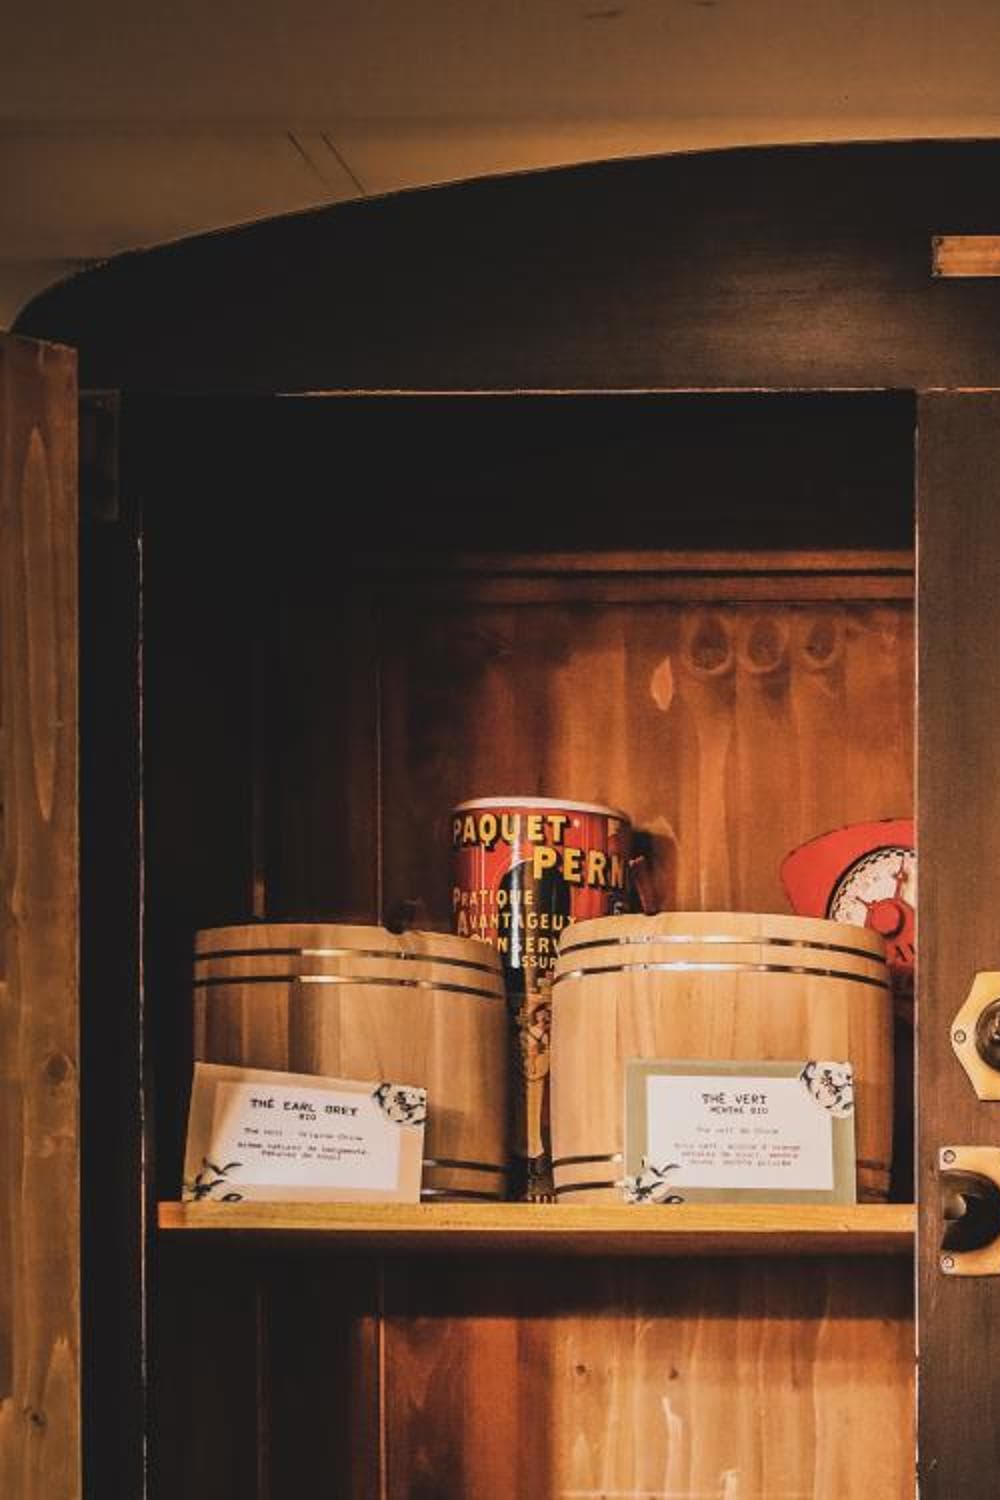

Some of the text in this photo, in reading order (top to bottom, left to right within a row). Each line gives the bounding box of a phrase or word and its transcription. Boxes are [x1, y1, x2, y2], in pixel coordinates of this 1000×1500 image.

[453, 813, 567, 846] PAQUET
[735, 1093, 768, 1105] VERT
[283, 1102, 316, 1113] EARL
[325, 1105, 359, 1117] GREY
